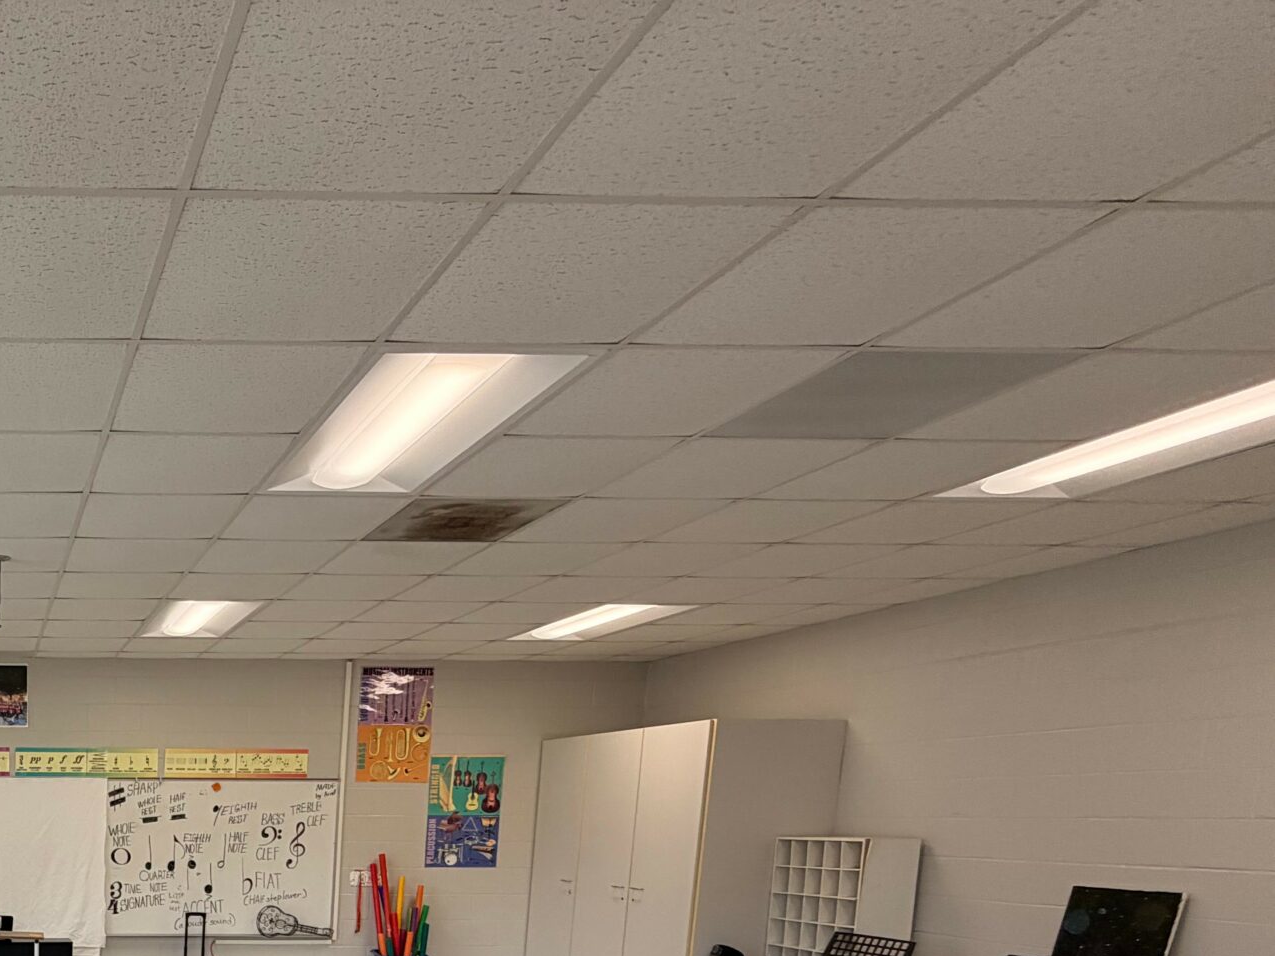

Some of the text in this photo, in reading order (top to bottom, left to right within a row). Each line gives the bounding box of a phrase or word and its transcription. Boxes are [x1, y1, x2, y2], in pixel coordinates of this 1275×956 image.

[127, 780, 159, 797] SHARP
[141, 805, 157, 816] REST
[169, 803, 186, 814] REST
[220, 802, 257, 817] EIGHTH
[290, 801, 322, 816] TREBLE
[228, 814, 248, 825] REST
[261, 812, 285, 826] BASS
[112, 835, 131, 847] NOTE
[229, 832, 250, 843] HALF
[426, 818, 437, 865] PERCUSSION
[185, 843, 204, 854] NOTE
[228, 842, 247, 854] NOTE
[150, 882, 168, 892] NOTE
[120, 893, 166, 912] SIGNATURE
[182, 899, 224, 917] ACCENT
